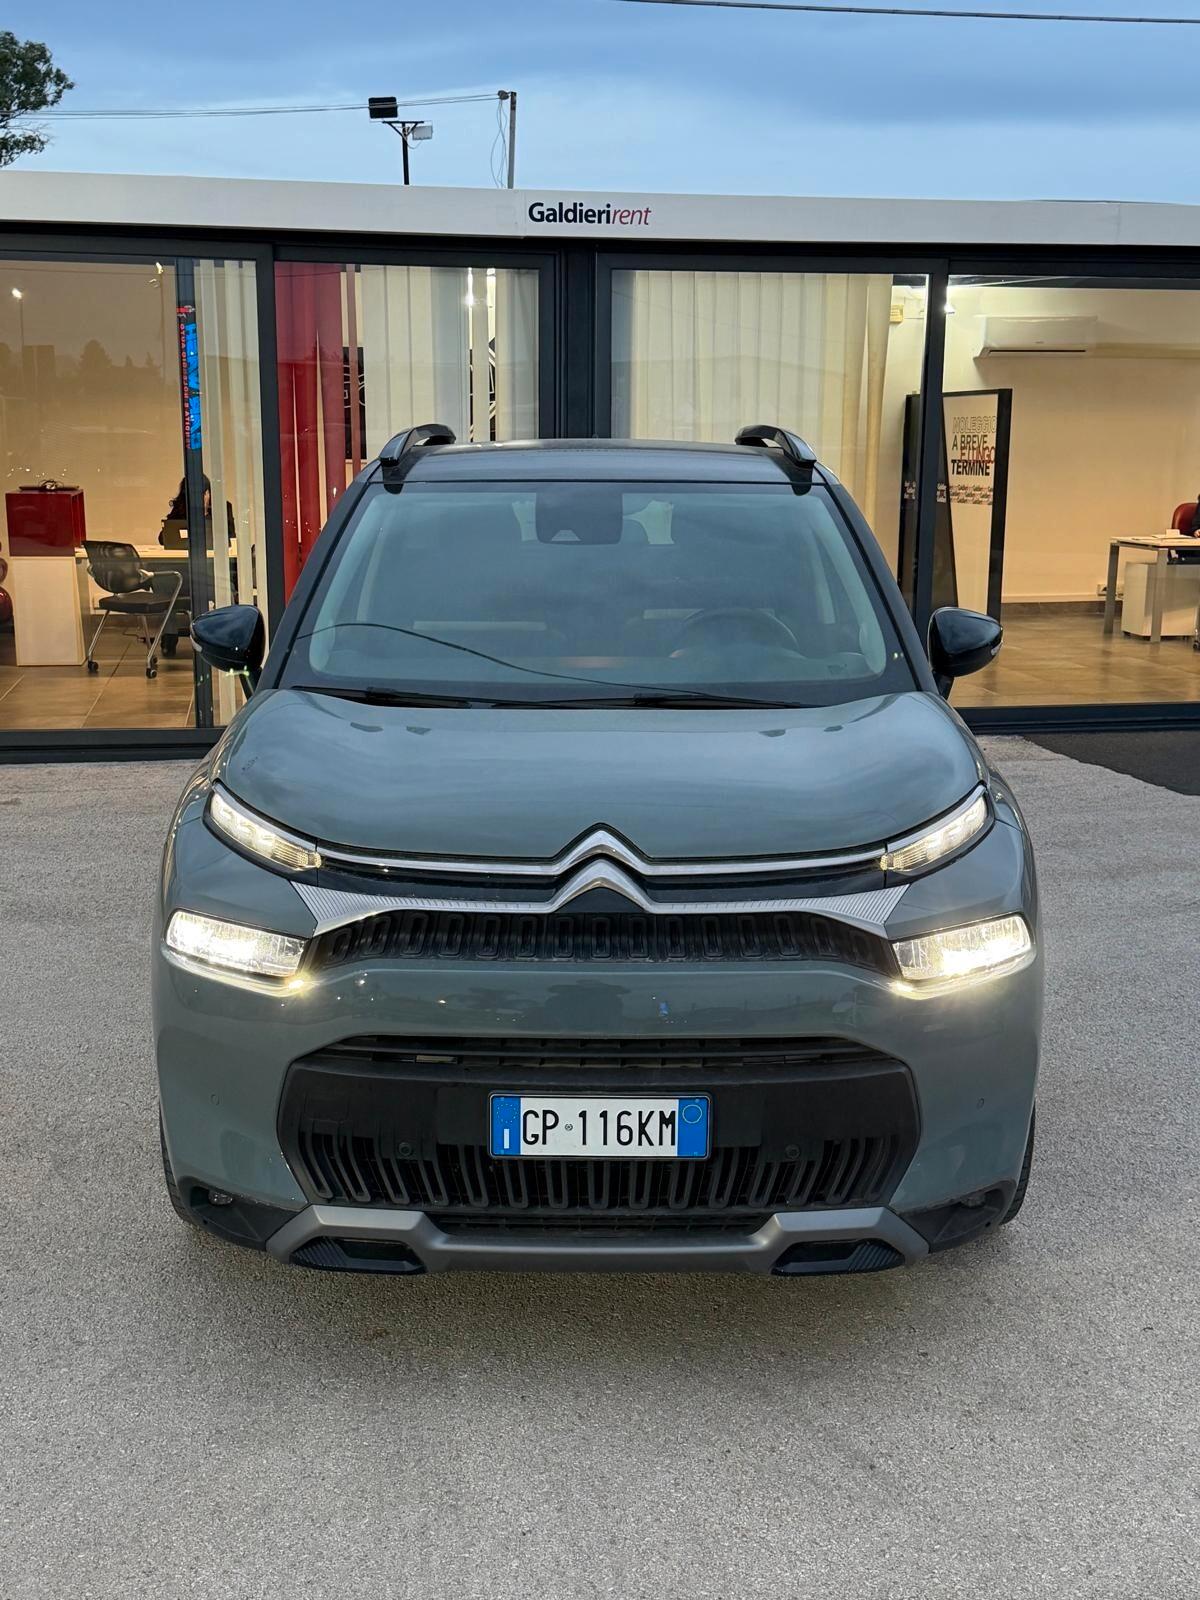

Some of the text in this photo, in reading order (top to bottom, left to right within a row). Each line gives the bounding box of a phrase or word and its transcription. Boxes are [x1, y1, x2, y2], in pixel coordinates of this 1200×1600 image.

[952, 434, 988, 451] A BREVE
[951, 459, 990, 476] TERMINE
